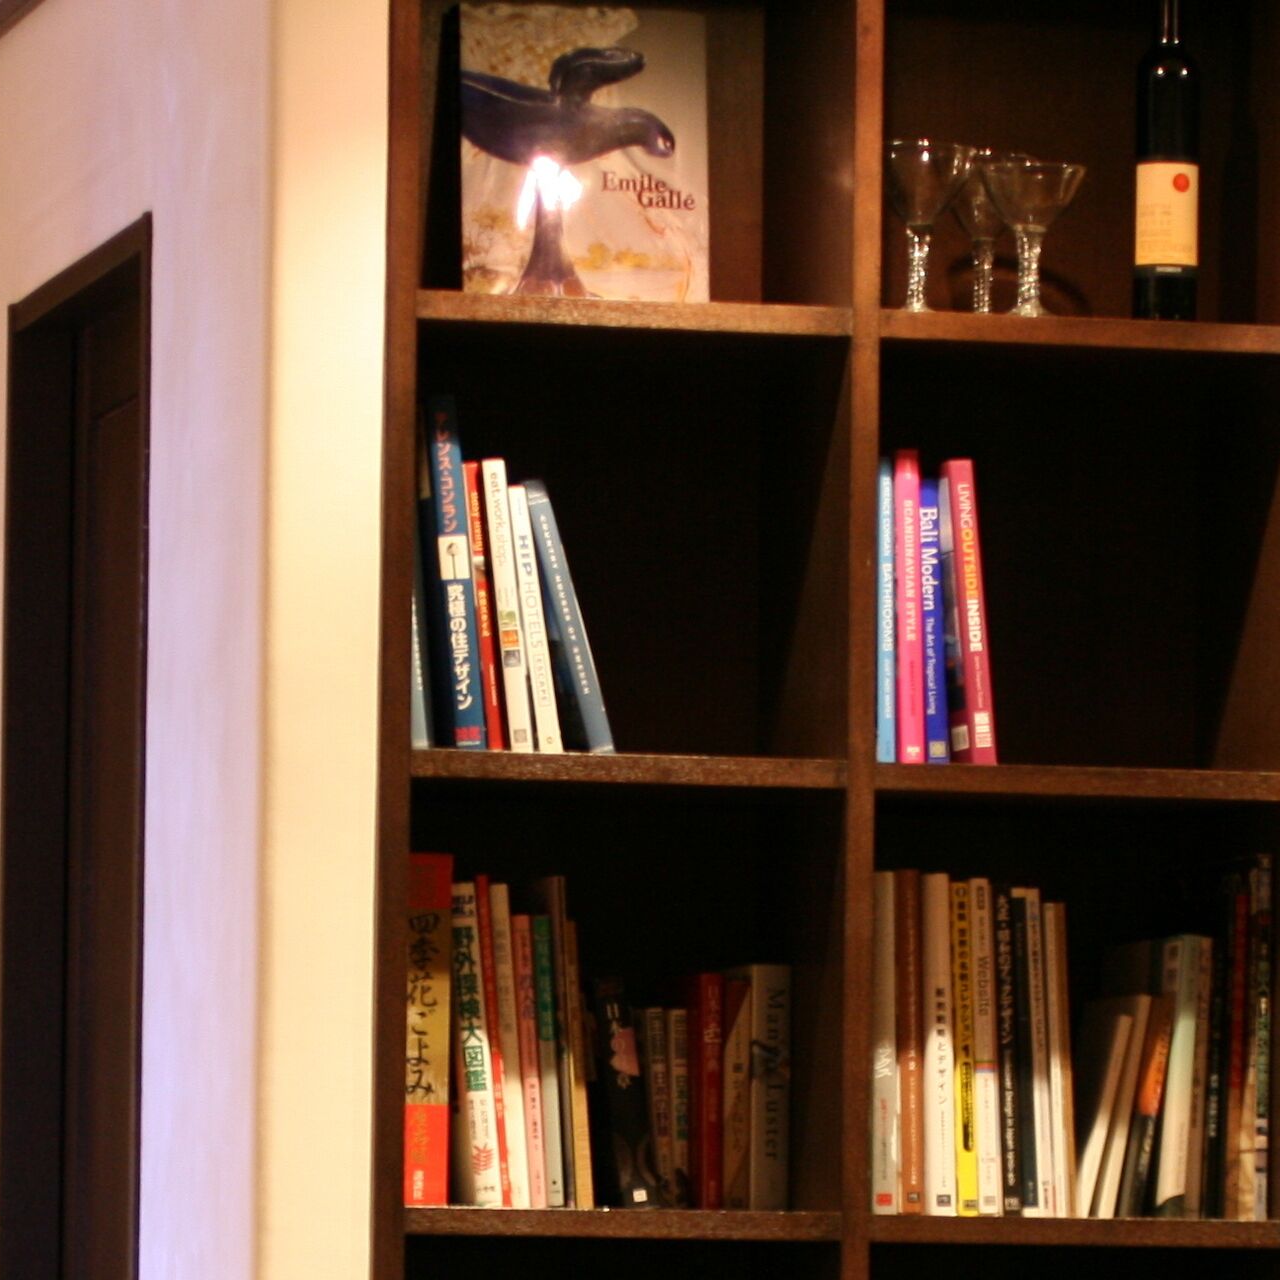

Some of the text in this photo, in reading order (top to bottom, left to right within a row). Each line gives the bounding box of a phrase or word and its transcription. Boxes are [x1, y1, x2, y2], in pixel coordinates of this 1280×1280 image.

[601, 171, 667, 194] Emile
[637, 188, 696, 211] Gallé
[519, 535, 533, 577] HIP
[903, 499, 917, 641] SCANDINAVIAN STYLE
[919, 507, 939, 611] Bali Modern
[524, 582, 544, 649] HOTELS
[882, 562, 895, 652] BATHROOMS
[926, 617, 935, 633] The
[446, 584, 474, 711] 究極の住デザイン
[926, 634, 935, 648] Art
[926, 658, 937, 691] Tropical
[927, 691, 937, 715] Living
[977, 956, 991, 1016] Website
[1004, 1090, 1014, 1117] Design
[765, 1084, 785, 1161] Luster
[1006, 1127, 1015, 1150] Japan
